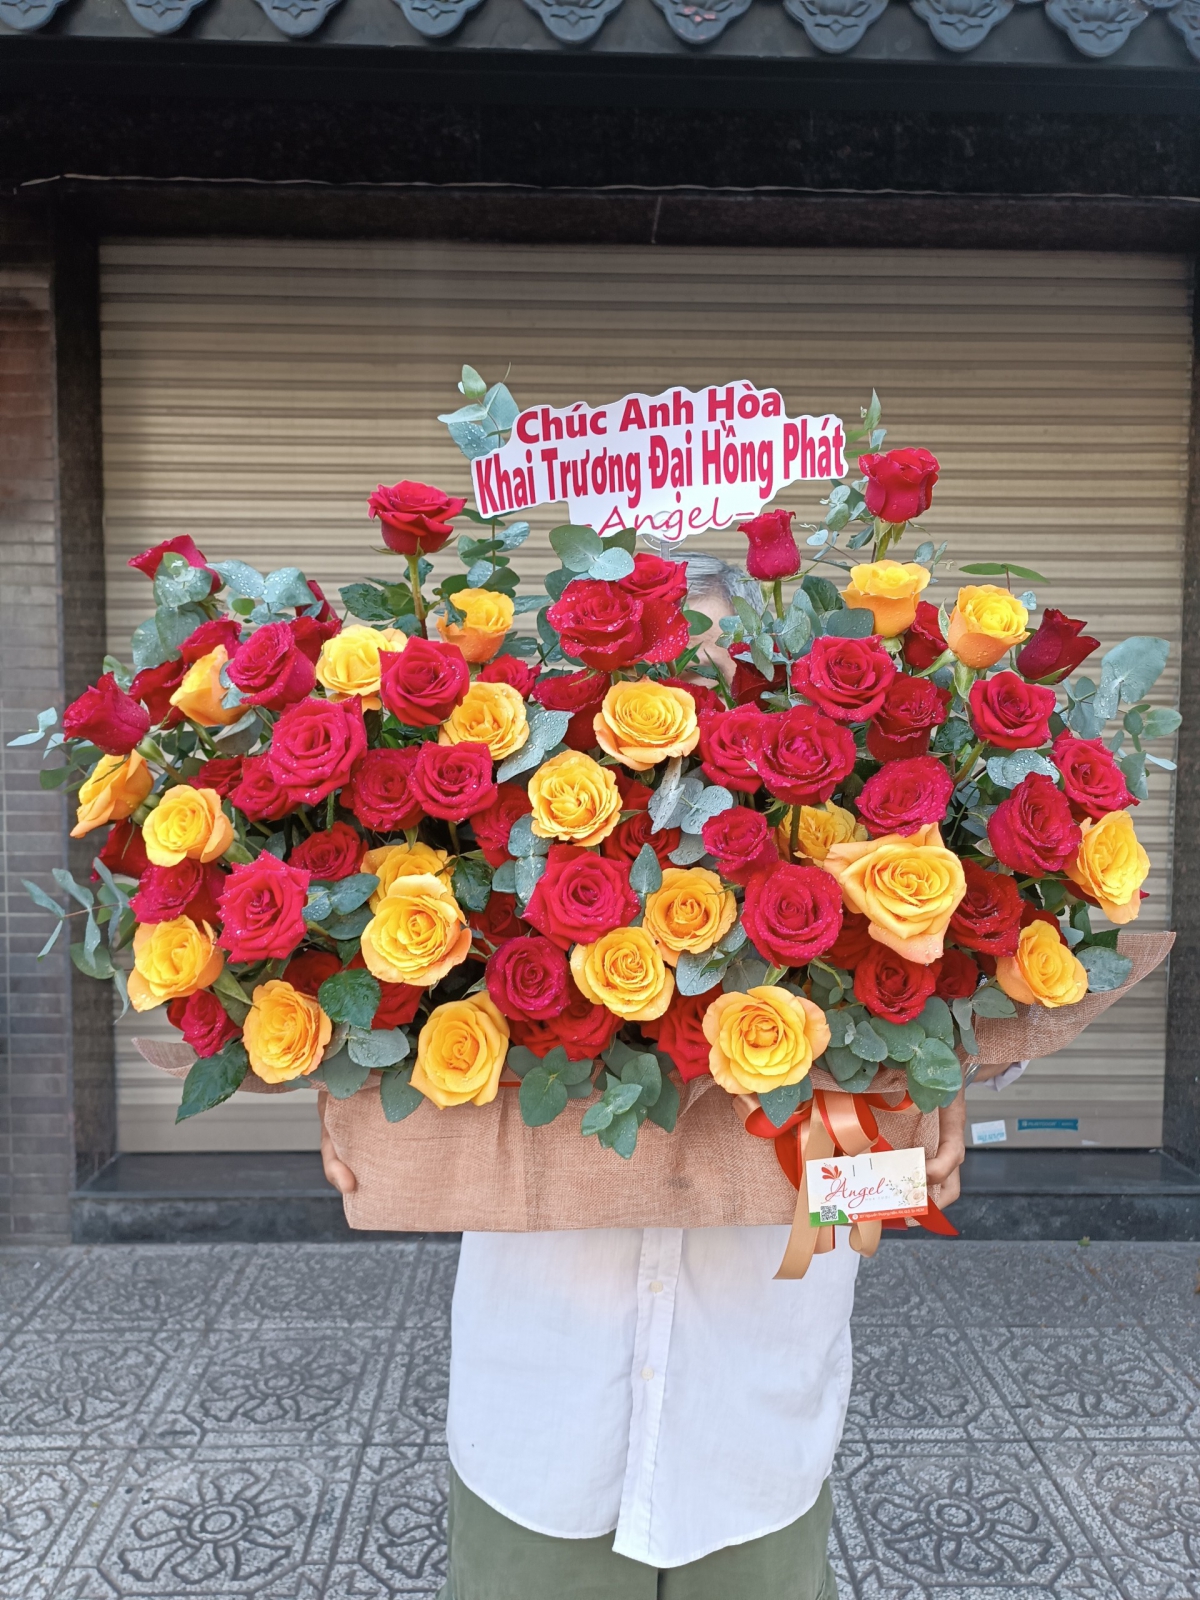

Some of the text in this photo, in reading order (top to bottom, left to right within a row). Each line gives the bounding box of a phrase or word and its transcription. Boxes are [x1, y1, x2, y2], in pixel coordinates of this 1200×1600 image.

[516, 383, 781, 445] Chúc Anh Hòa
[475, 413, 844, 515] Khai Trương Đại Hồng Phát
[822, 1177, 886, 1209] Angel
